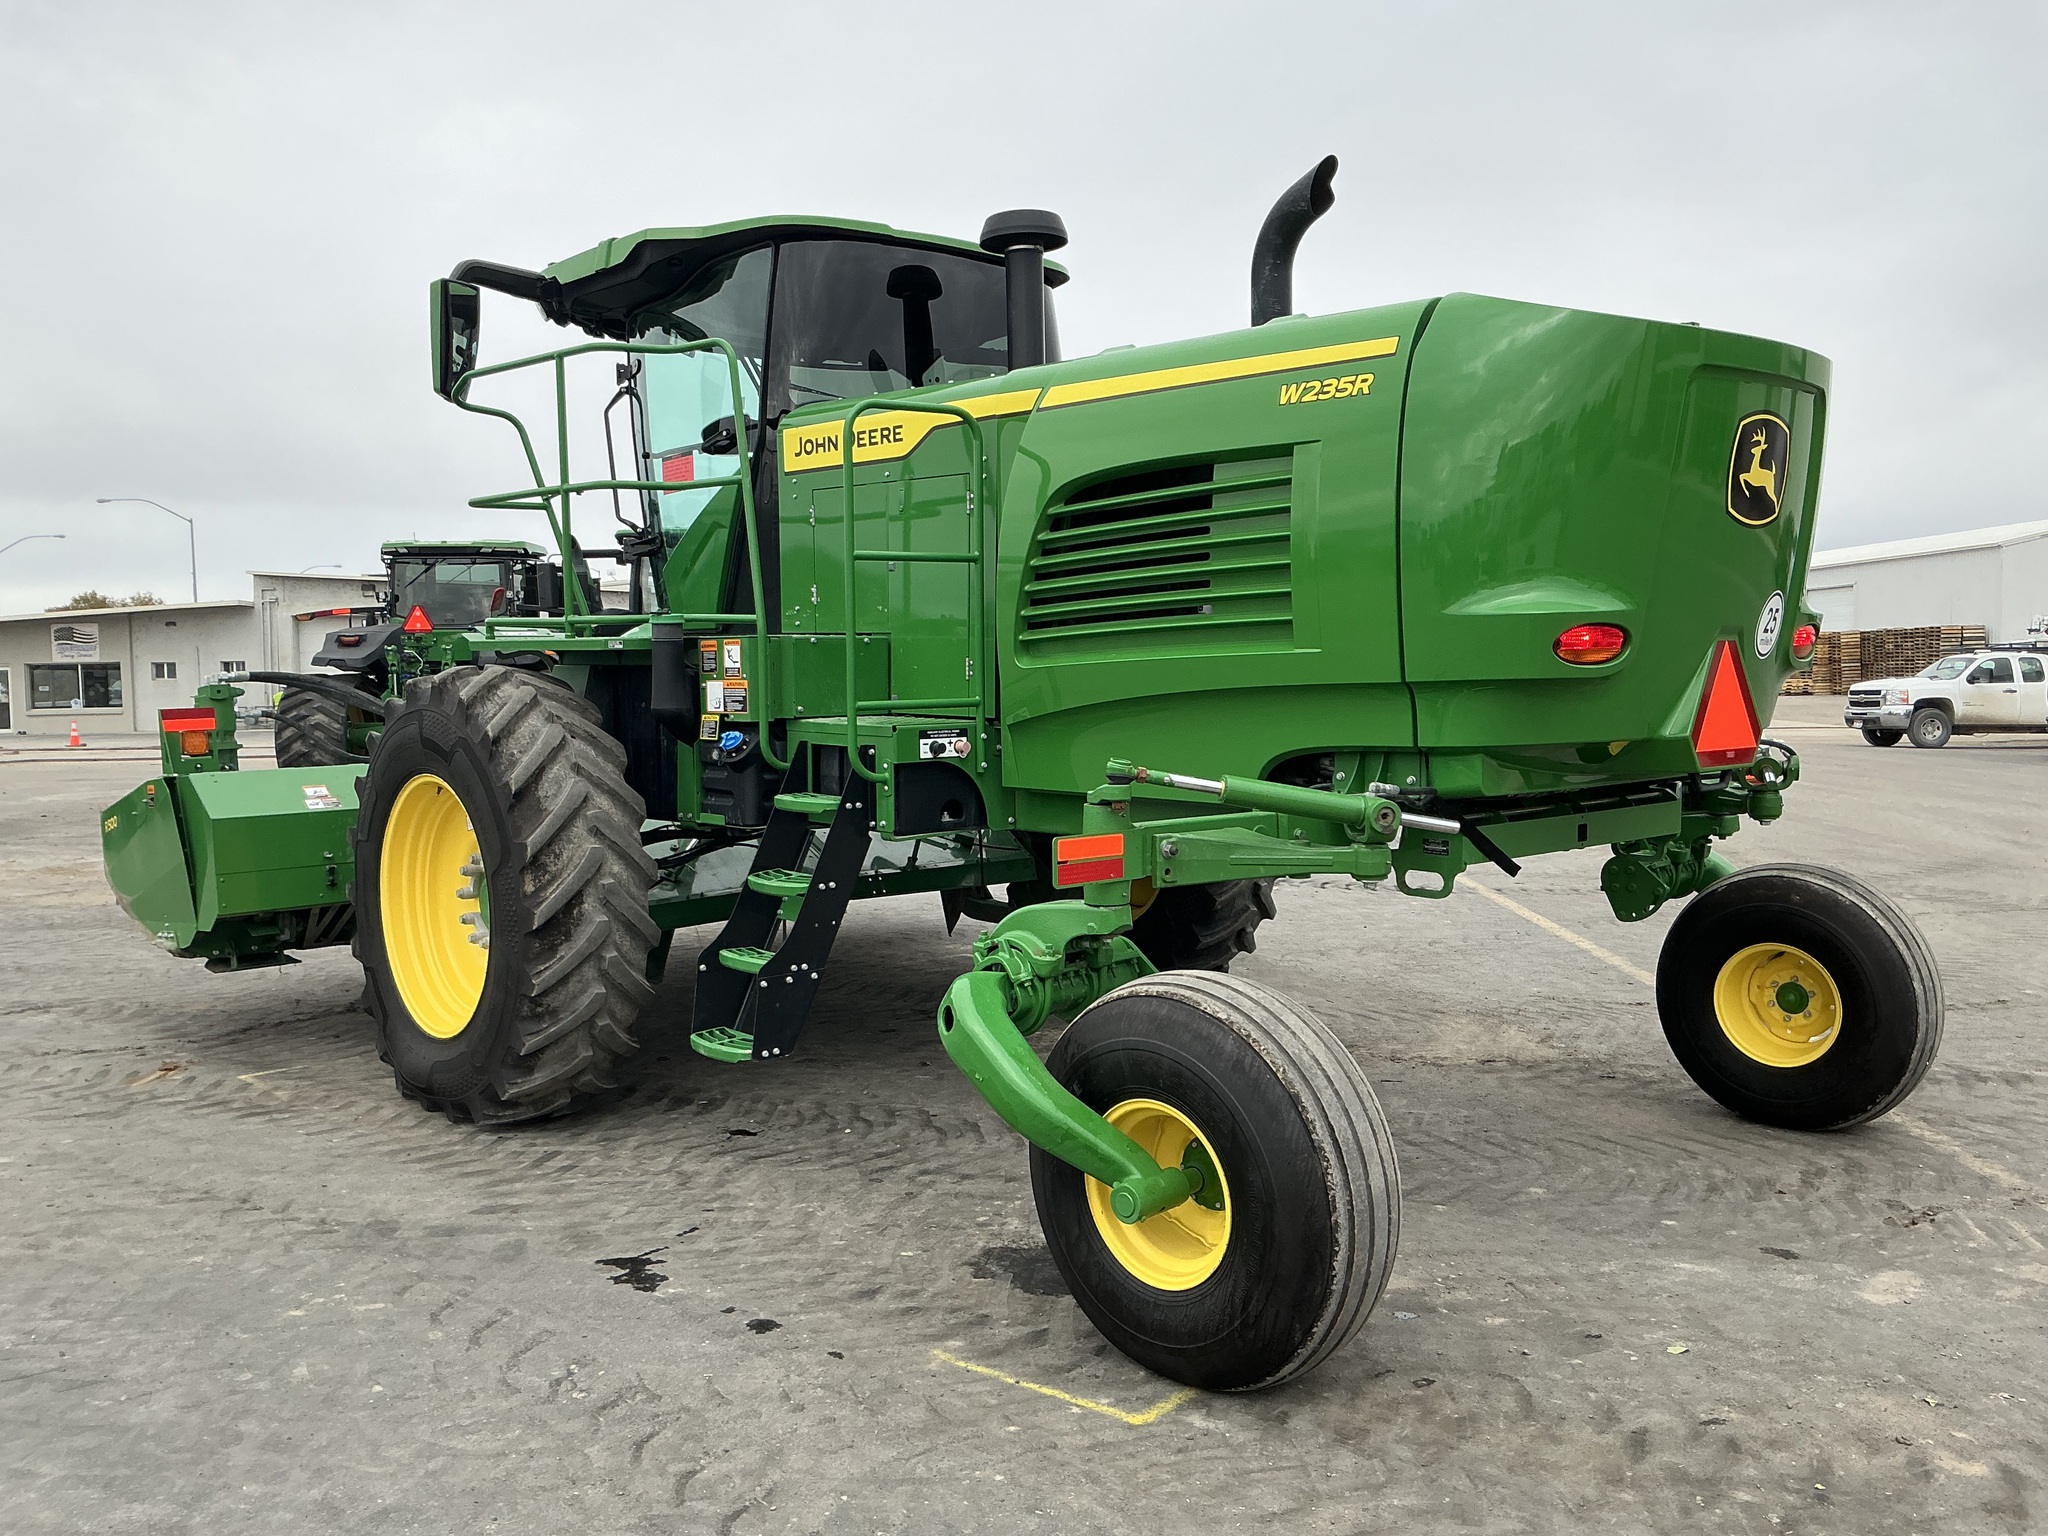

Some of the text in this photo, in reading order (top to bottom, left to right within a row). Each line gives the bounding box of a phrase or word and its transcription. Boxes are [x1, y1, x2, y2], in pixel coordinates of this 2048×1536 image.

[1279, 372, 1375, 406] W235R
[794, 434, 839, 458] JOHN
[1763, 607, 1780, 634] 25
[104, 815, 118, 833] R500
